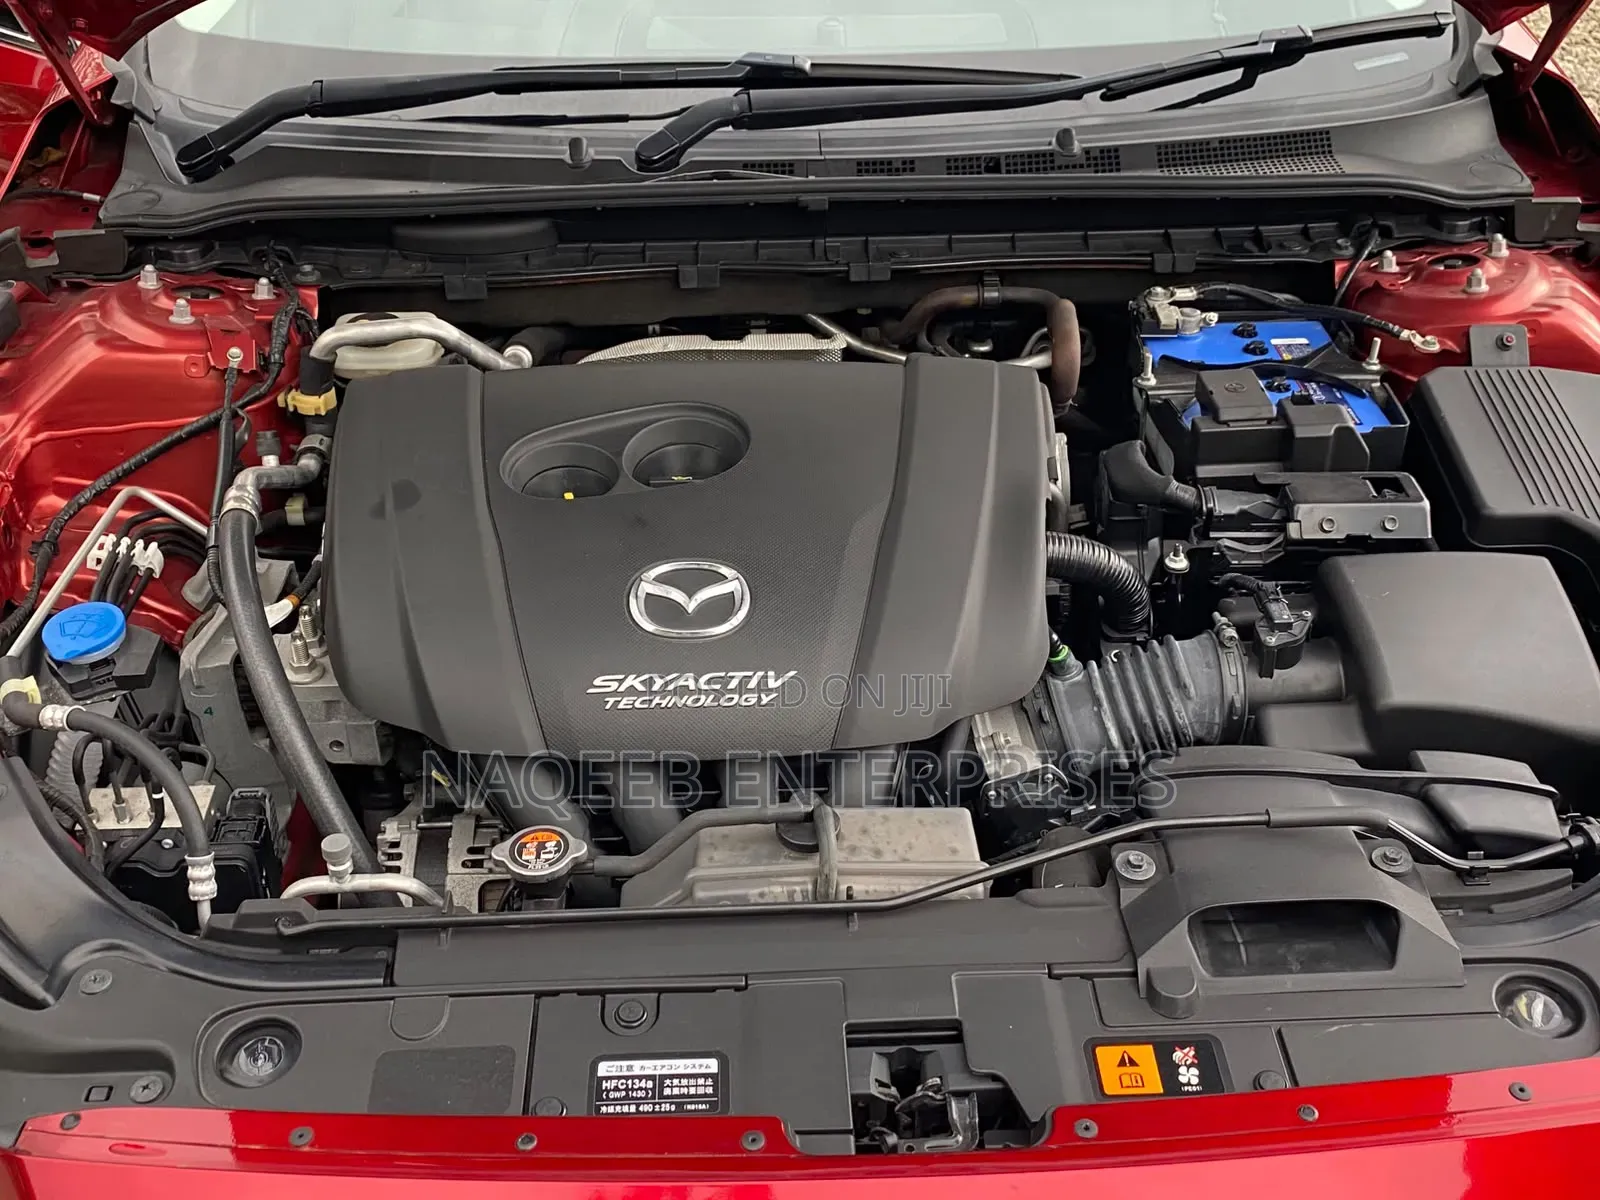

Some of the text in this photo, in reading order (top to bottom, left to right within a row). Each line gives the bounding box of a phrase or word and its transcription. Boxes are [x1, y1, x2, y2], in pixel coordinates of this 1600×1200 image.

[586, 671, 798, 694] SKYACTIV
[603, 692, 779, 710] TECHNOLOGY
[605, 1064, 635, 1073] ご注意
[602, 1078, 653, 1090] HFC134a
